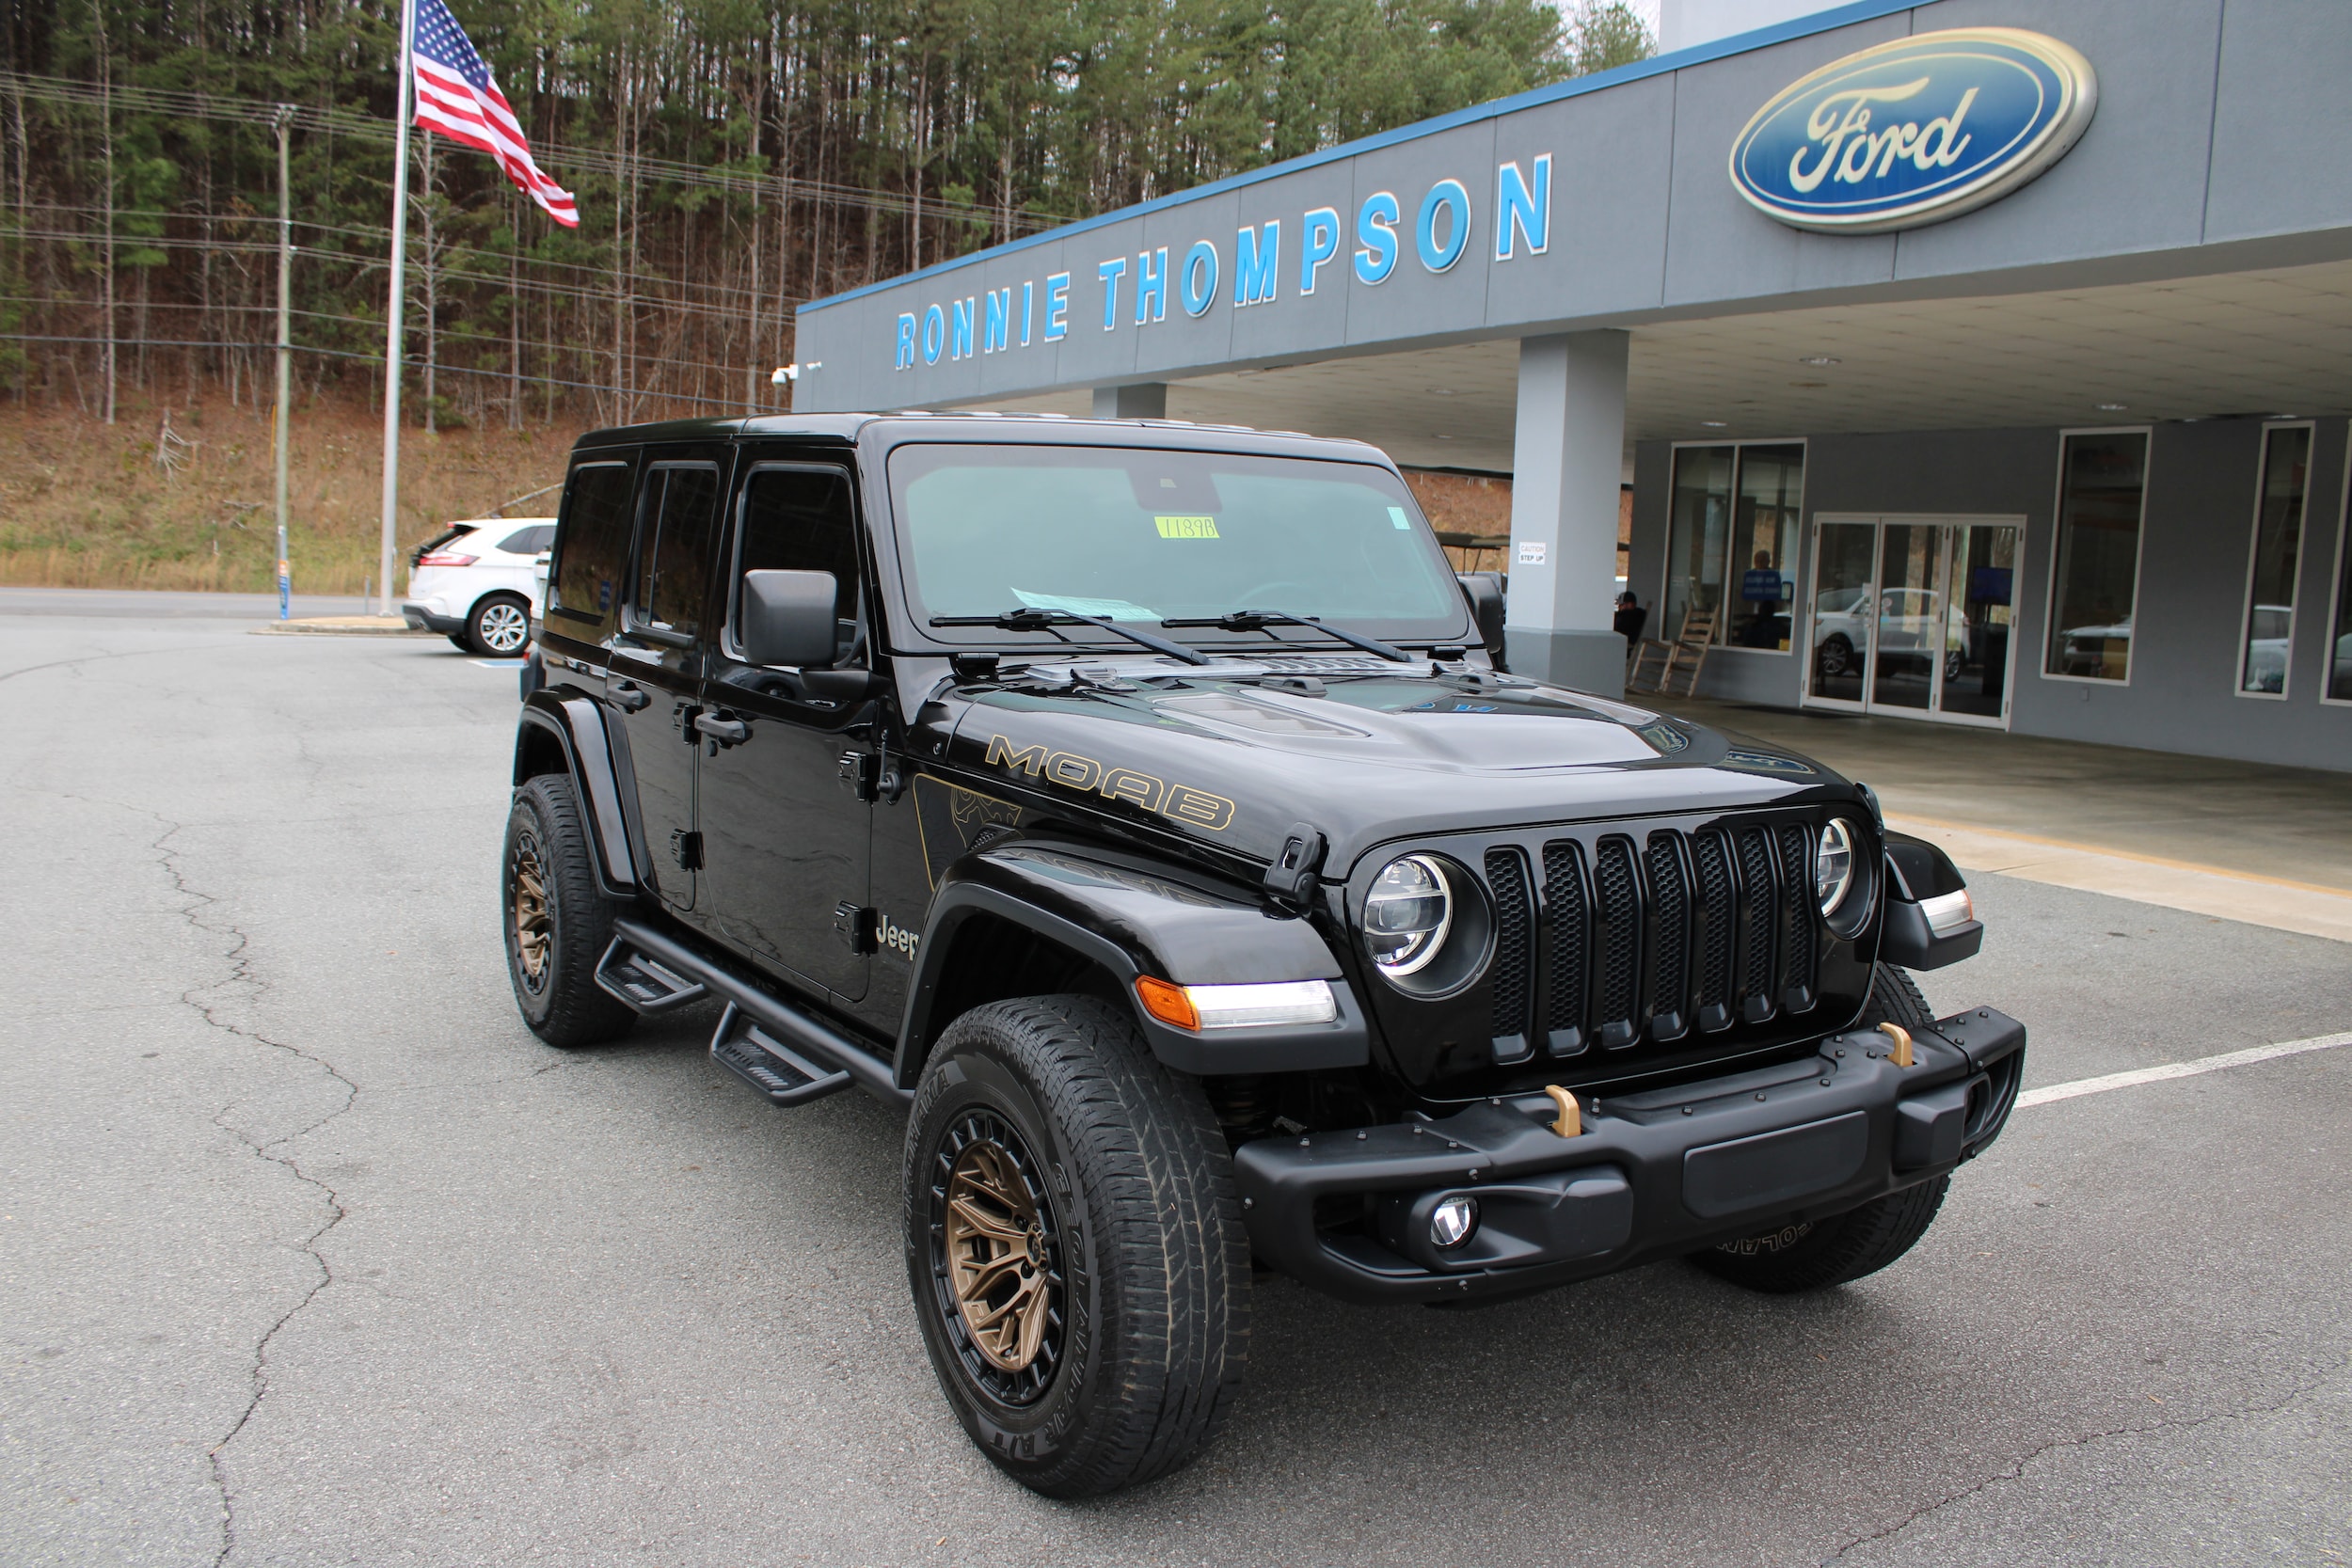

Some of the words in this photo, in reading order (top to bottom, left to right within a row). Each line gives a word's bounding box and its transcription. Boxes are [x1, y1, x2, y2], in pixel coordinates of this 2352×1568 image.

[1788, 77, 1979, 193] Ford
[896, 271, 1070, 371] RONNIE
[1099, 152, 1553, 331] THOMPSON
[1166, 518, 1215, 537] 1189B
[985, 734, 1235, 832] MOAB
[876, 914, 919, 961] Jeep
